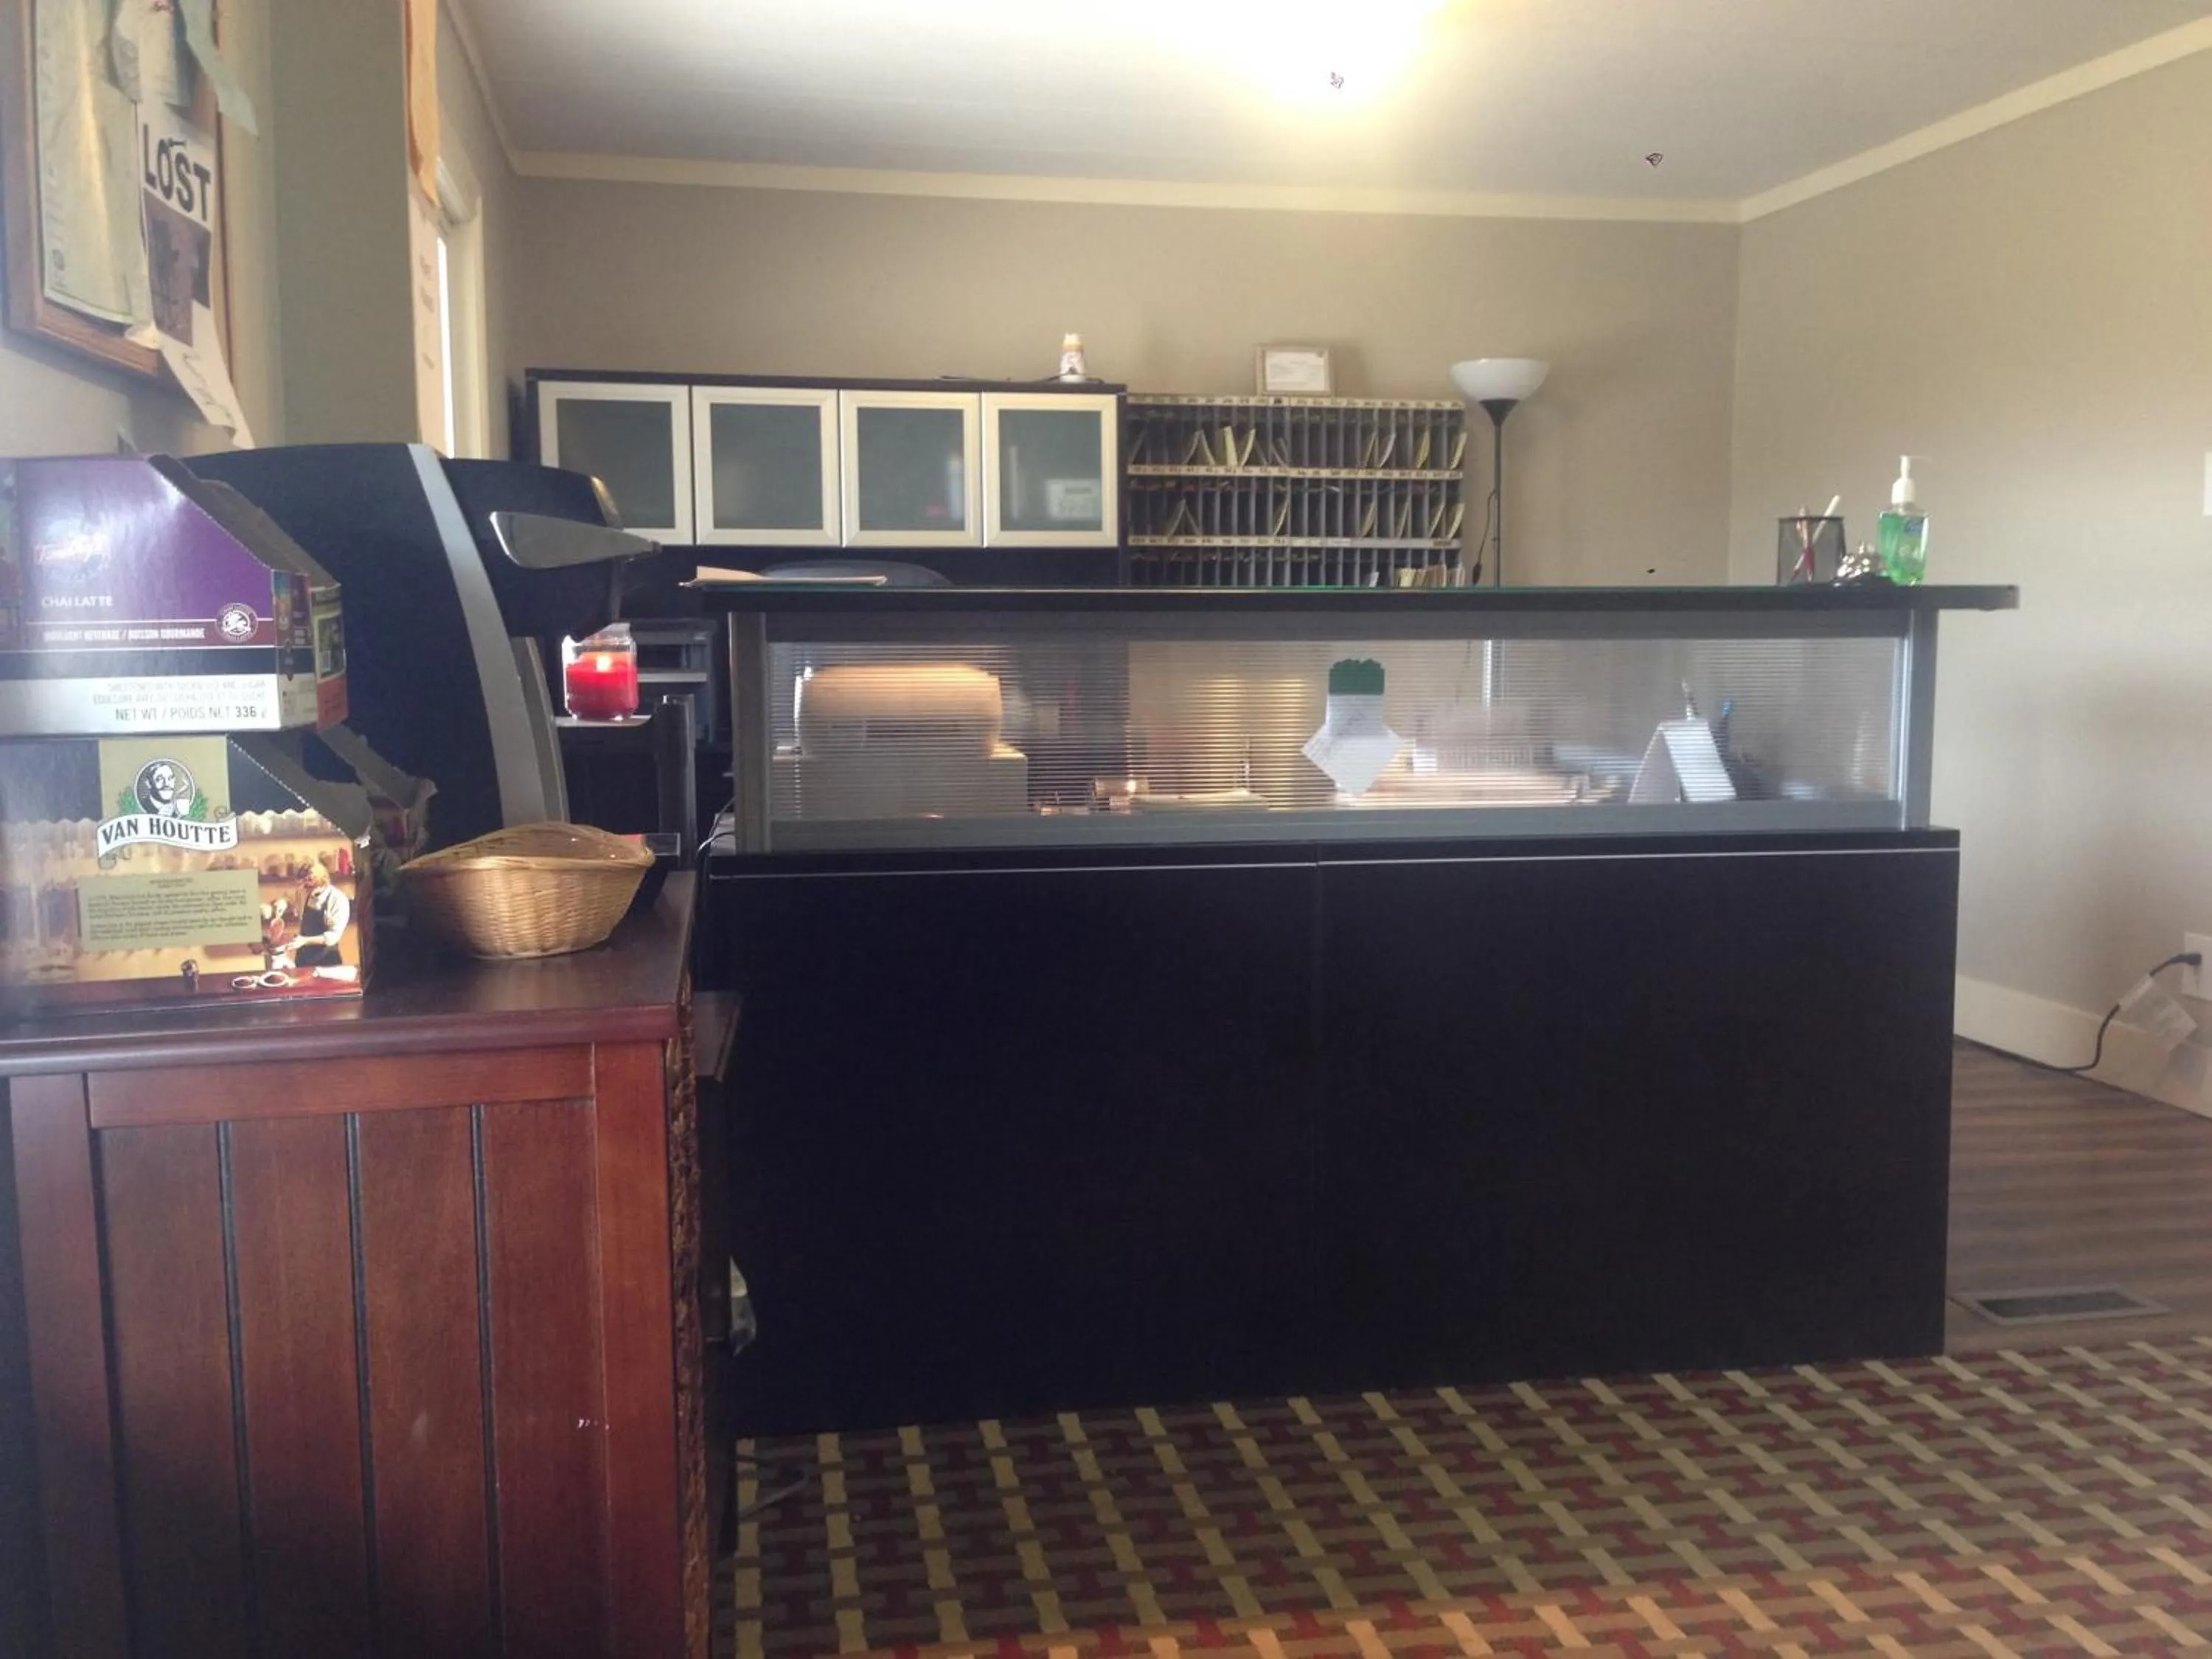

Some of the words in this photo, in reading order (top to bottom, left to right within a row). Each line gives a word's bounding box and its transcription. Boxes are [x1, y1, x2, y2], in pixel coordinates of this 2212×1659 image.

[143, 124, 211, 220] LOST
[41, 596, 72, 608] CHAI
[74, 595, 113, 607] LATTE
[115, 709, 136, 720] NET
[141, 708, 157, 720] WT
[170, 707, 206, 720] POIDS
[209, 707, 229, 719] NET
[235, 706, 257, 717] 336
[101, 818, 138, 845] VAN
[149, 818, 230, 844] HOUTTE
